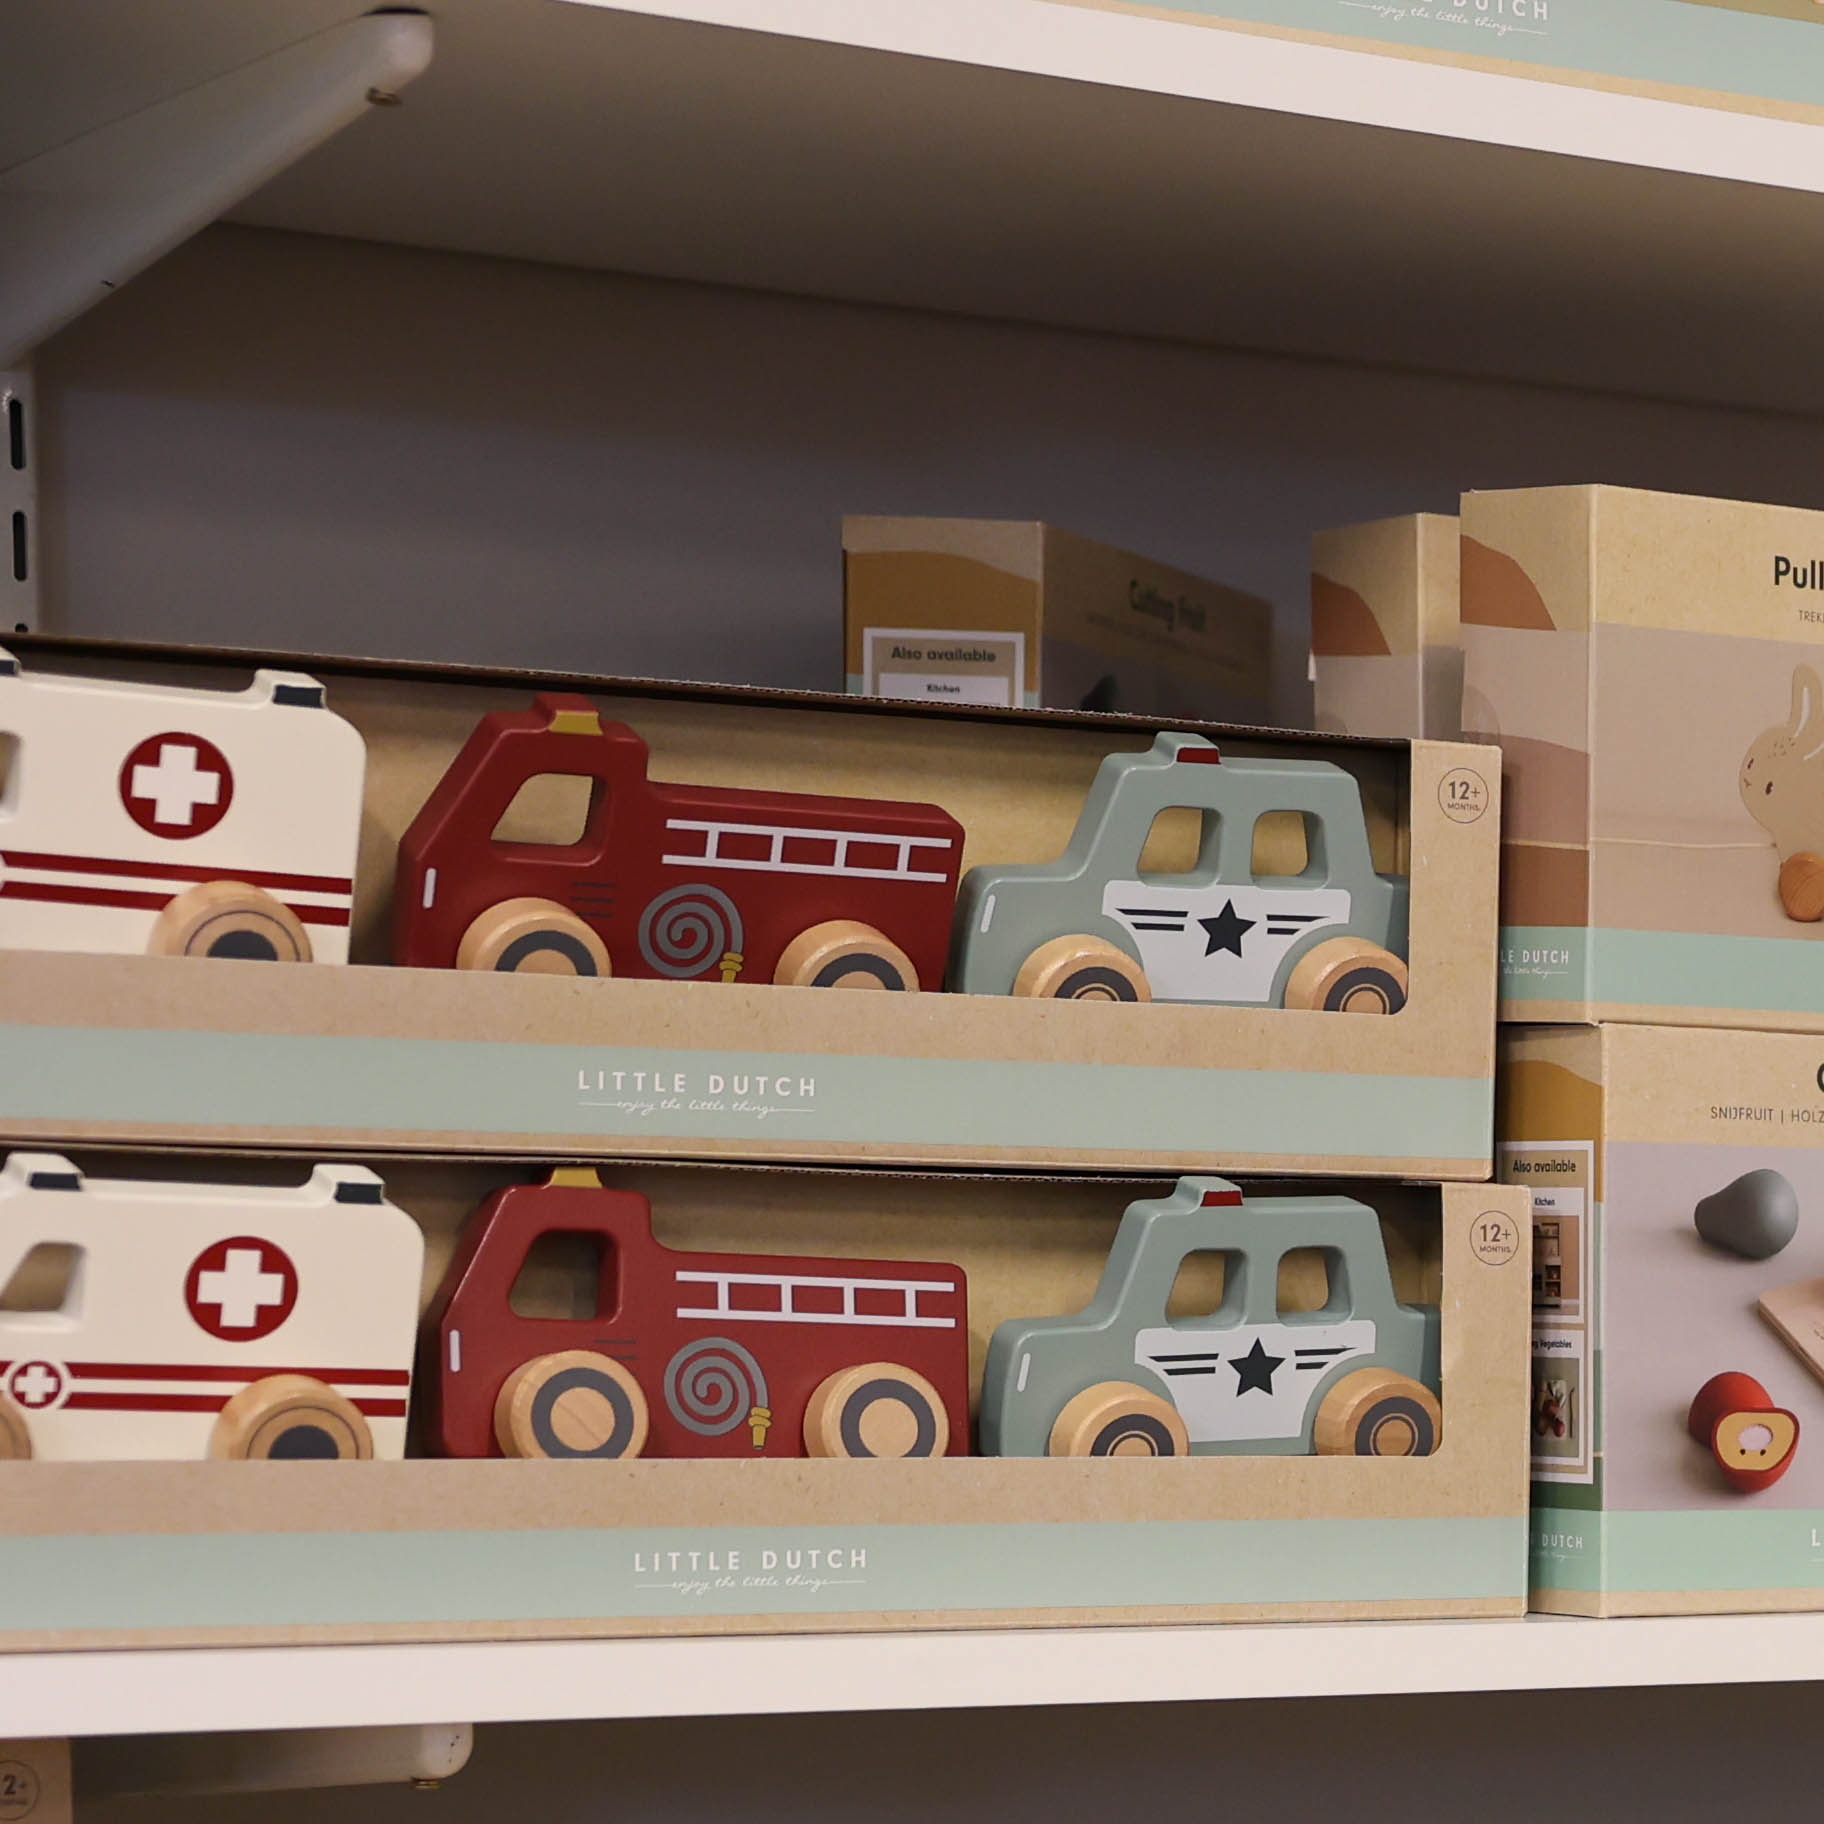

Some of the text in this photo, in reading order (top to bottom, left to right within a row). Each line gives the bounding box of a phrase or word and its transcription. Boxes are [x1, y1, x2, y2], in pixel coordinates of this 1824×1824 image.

[1410, 7, 1430, 19] the
[1435, 10, 1469, 25] little
[1773, 555, 1824, 591] Pull
[890, 646, 996, 663] Also available
[1448, 780, 1481, 800] 12+
[1522, 950, 1569, 966] DUTCH
[577, 1069, 816, 1097] LITTLE DUTCH
[1512, 1159, 1577, 1173] Also available
[1479, 1223, 1512, 1242] 12+
[1542, 1534, 1584, 1549] DUTCH
[634, 1548, 868, 1572] LITTLE DUTCH
[672, 1580, 711, 1595] enjoy
[714, 1575, 735, 1588] the
[742, 1575, 779, 1587] little
